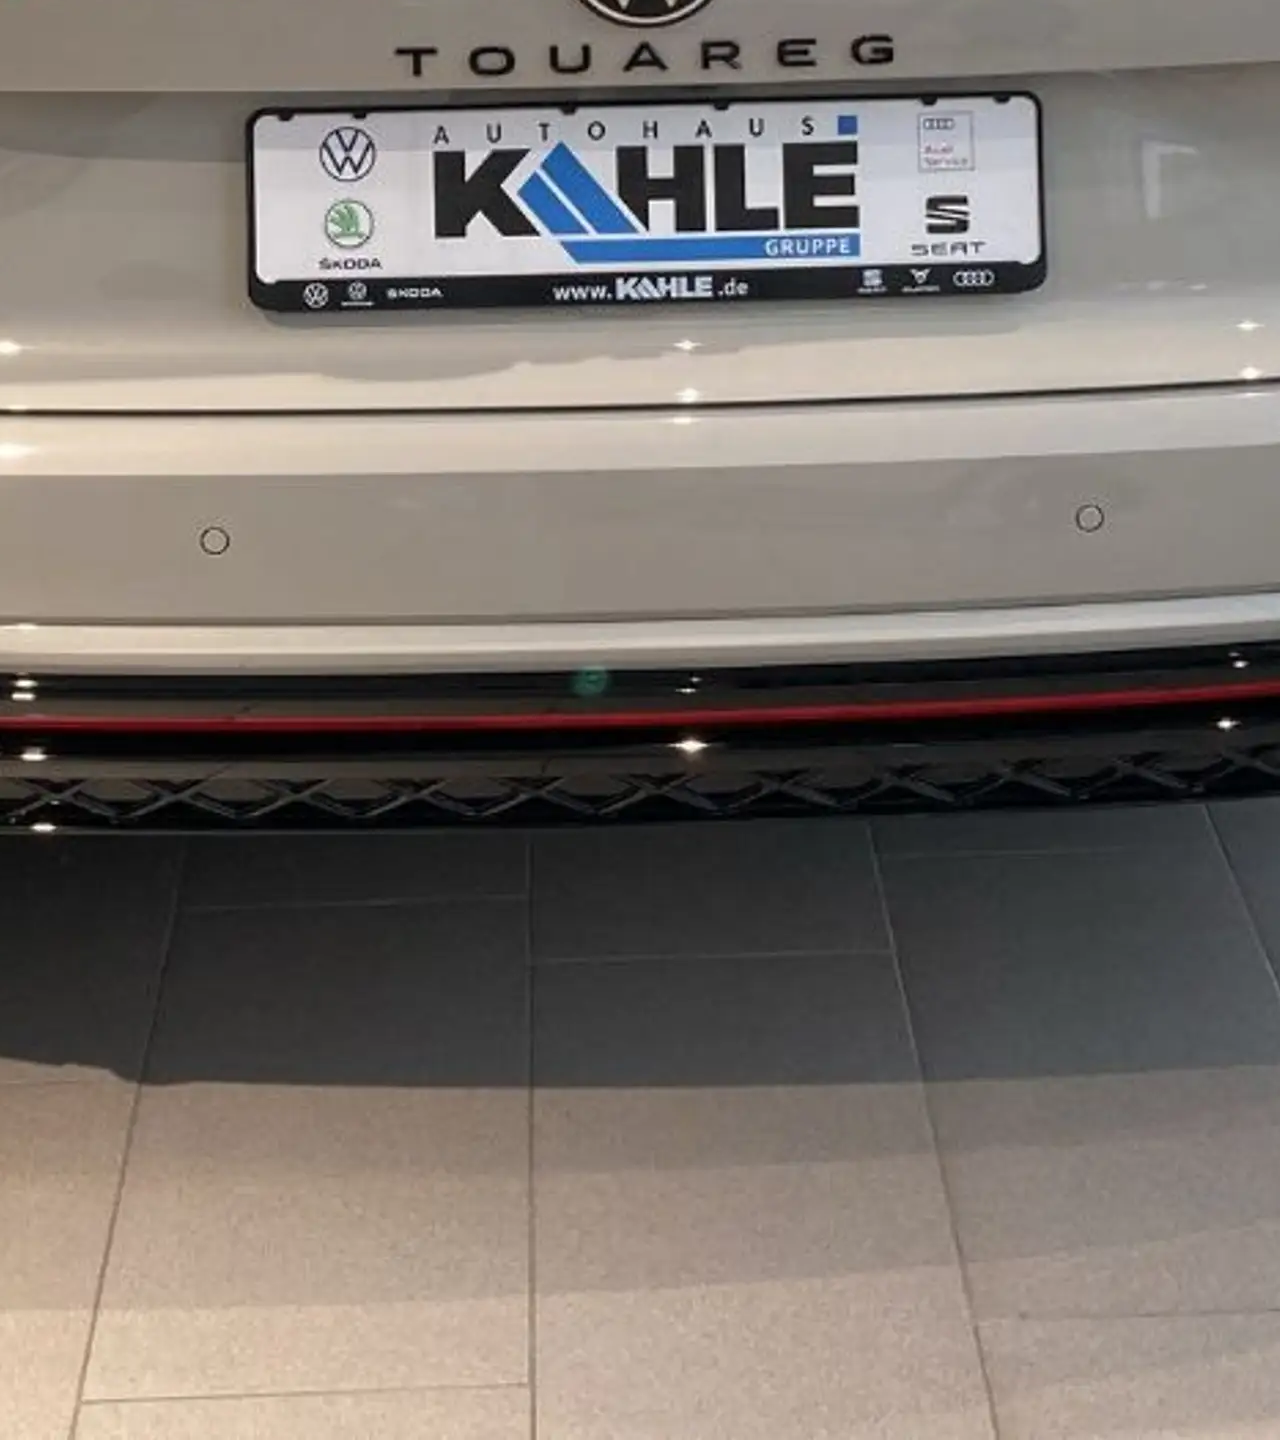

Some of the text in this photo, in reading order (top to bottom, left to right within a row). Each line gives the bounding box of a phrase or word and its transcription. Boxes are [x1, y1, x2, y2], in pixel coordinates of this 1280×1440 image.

[395, 35, 896, 77] TOUAREG
[432, 116, 815, 145] AUTOHAUS
[432, 140, 861, 239] KAHLE
[764, 237, 851, 257] GRUPPE
[911, 240, 987, 257] SEAT
